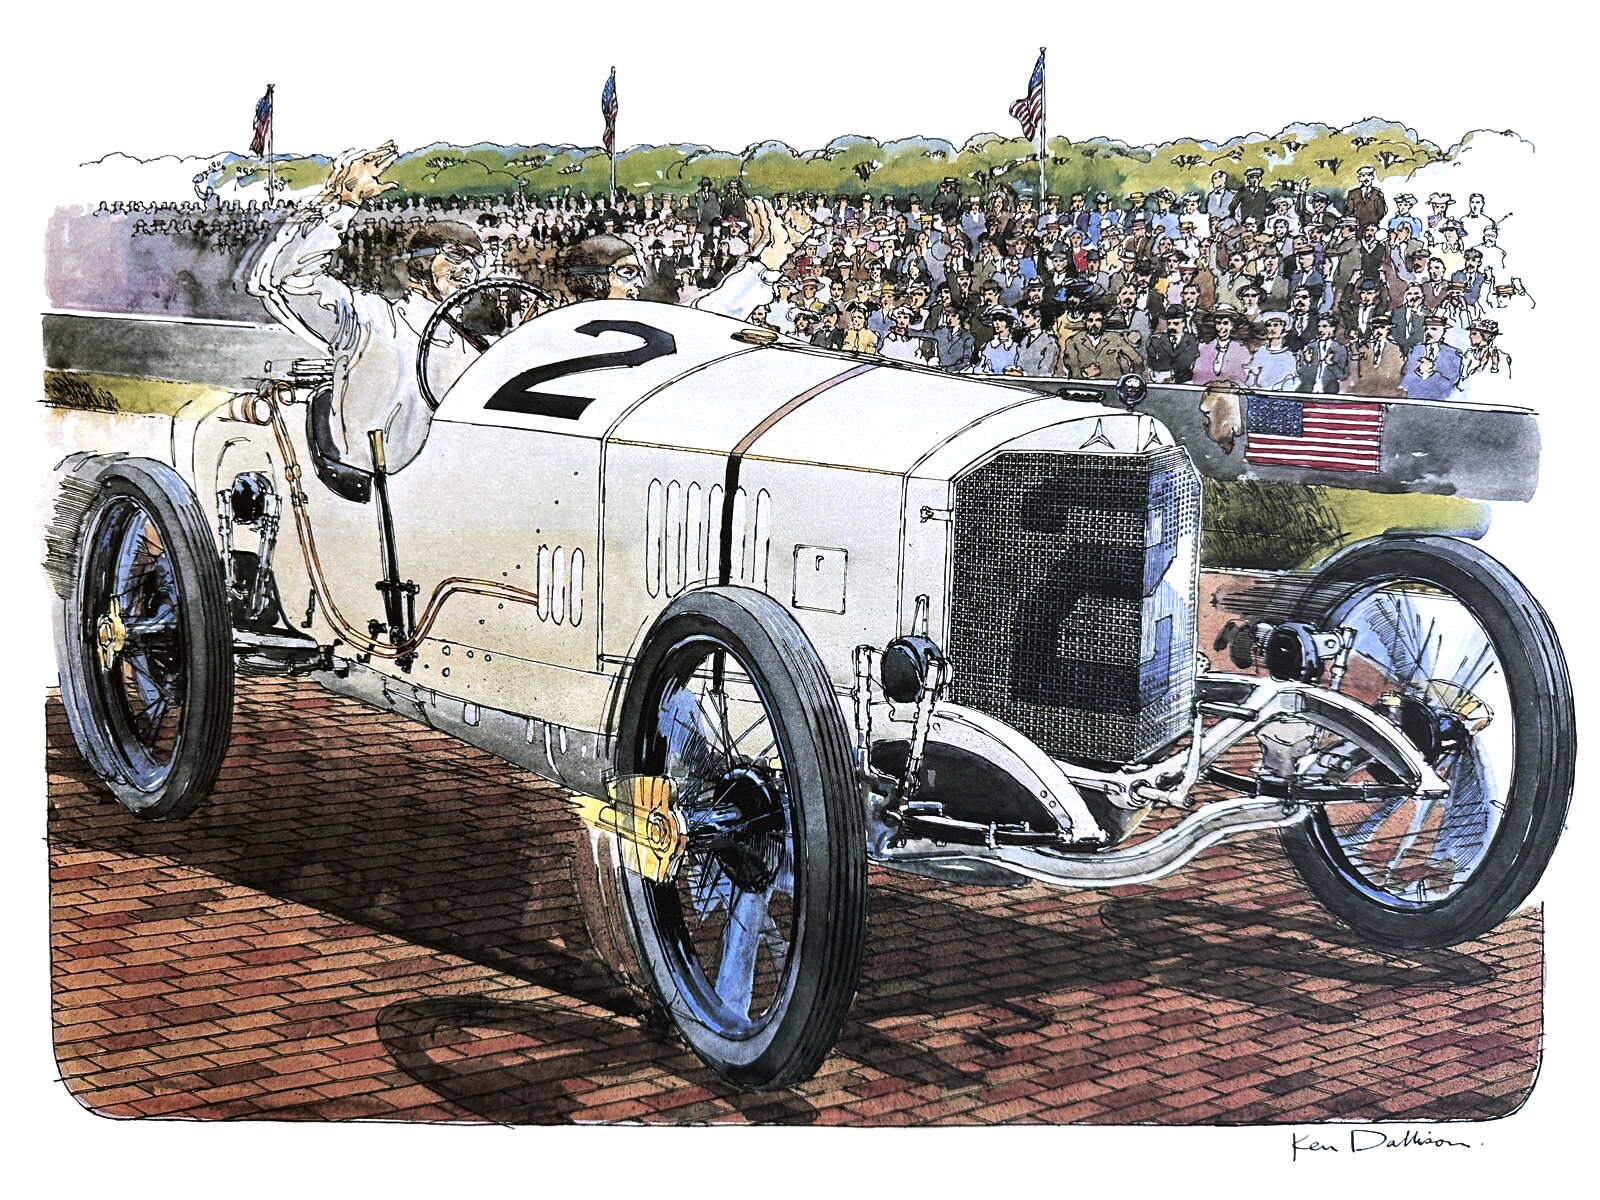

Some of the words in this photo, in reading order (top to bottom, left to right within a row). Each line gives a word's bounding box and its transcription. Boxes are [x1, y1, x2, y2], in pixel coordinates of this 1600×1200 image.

[483, 320, 677, 420] 2
[1010, 468, 1178, 713] 2
[1292, 1133, 1338, 1162] Ken
